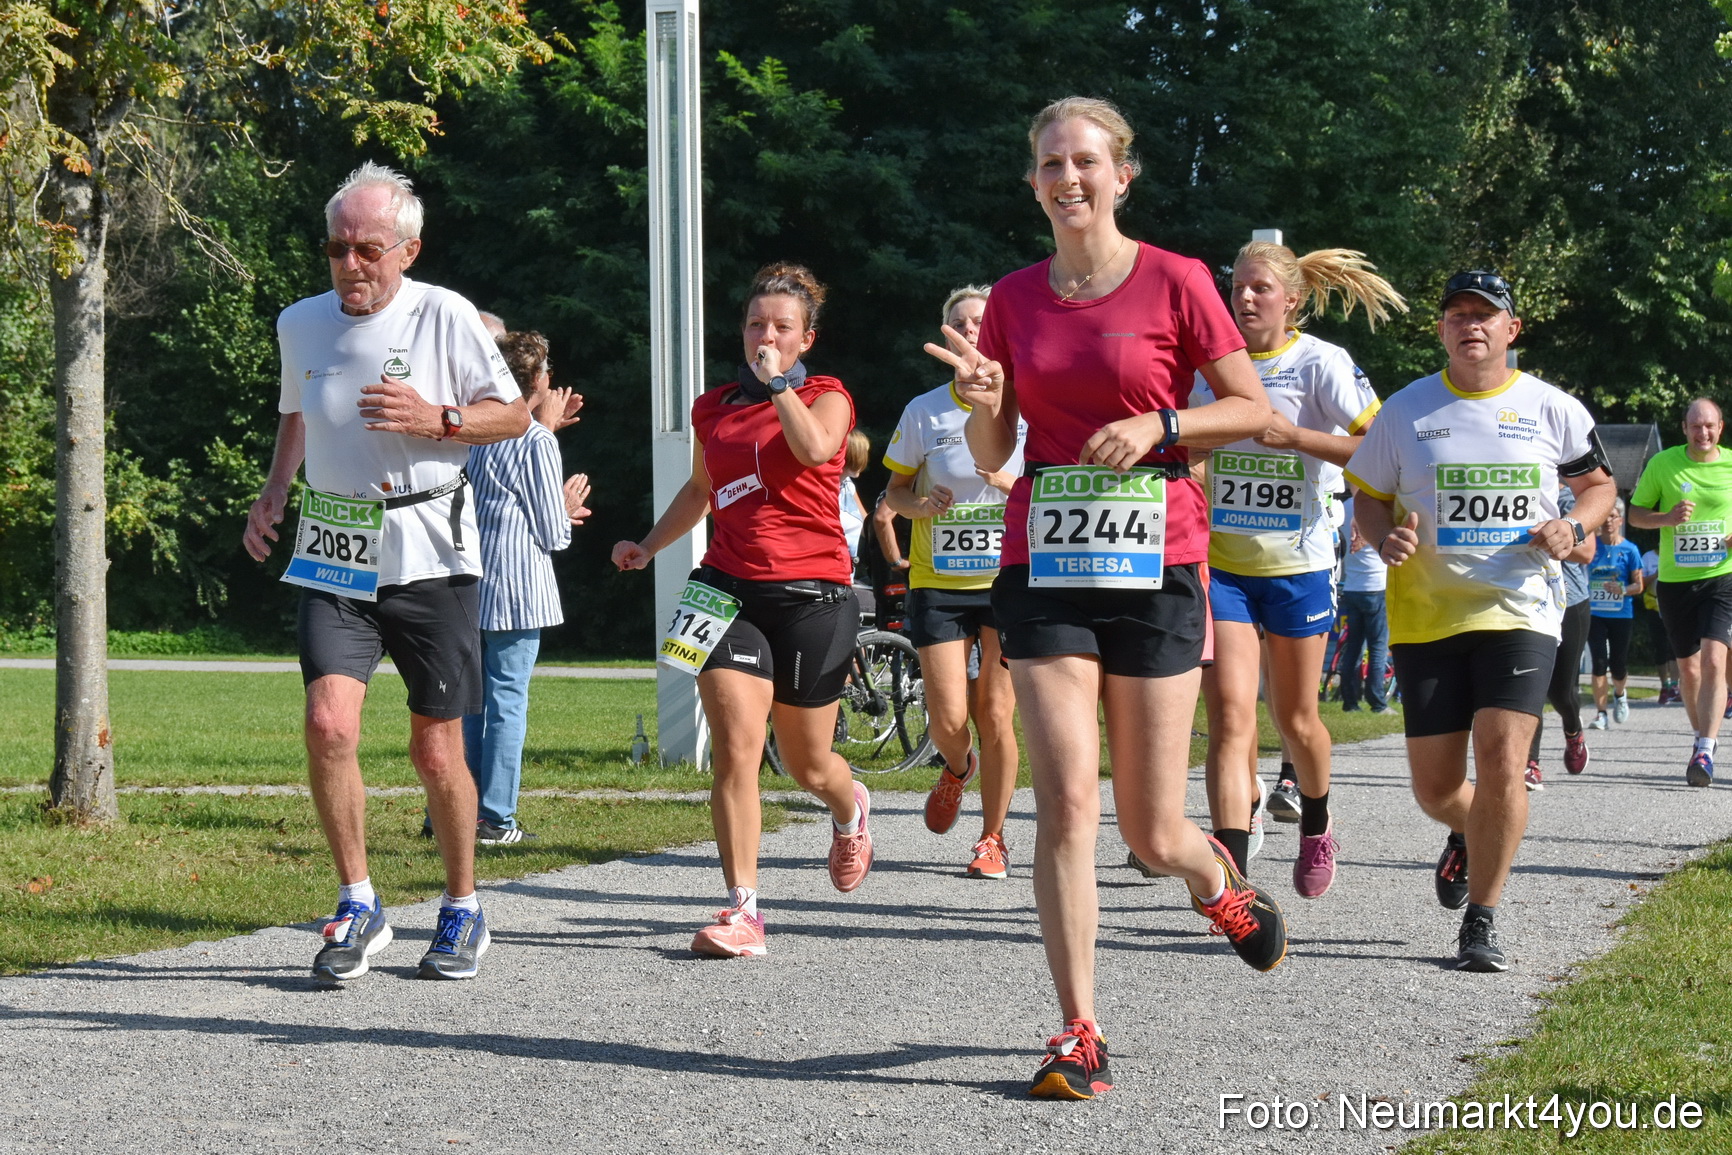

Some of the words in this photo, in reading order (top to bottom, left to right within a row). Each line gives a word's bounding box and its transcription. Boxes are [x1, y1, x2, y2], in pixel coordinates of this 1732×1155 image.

[1499, 410, 1518, 423] 20
[1417, 428, 1450, 438] BOCK
[1498, 423, 1542, 436] Neumarkter
[1498, 431, 1534, 443] Stadtlauf
[1220, 454, 1298, 475] BOCK
[1445, 468, 1530, 485] BOCK
[727, 482, 748, 499] DEHN
[1041, 473, 1150, 497] BOCK
[1221, 480, 1294, 509] 2198
[310, 496, 371, 524] BOCK
[939, 507, 1004, 523] BOCK
[1448, 494, 1529, 522] 2048
[1042, 509, 1148, 545] 2244
[1152, 512, 1159, 520] D
[1222, 512, 1289, 528] JOHANNA
[1676, 522, 1720, 533] BOCK
[941, 529, 1004, 552] 2633
[1456, 528, 1520, 543] JÜRGEN
[306, 525, 369, 565] 2082
[371, 537, 378, 545] C
[1679, 537, 1721, 551] 2233
[947, 558, 1001, 569] BETTINA
[1055, 557, 1134, 573] TERESA
[1678, 554, 1723, 562] CHRISTIAN
[315, 567, 354, 585] WILLI
[682, 585, 726, 615] OCK
[1593, 590, 1620, 601] 2370
[668, 608, 712, 645] 314
